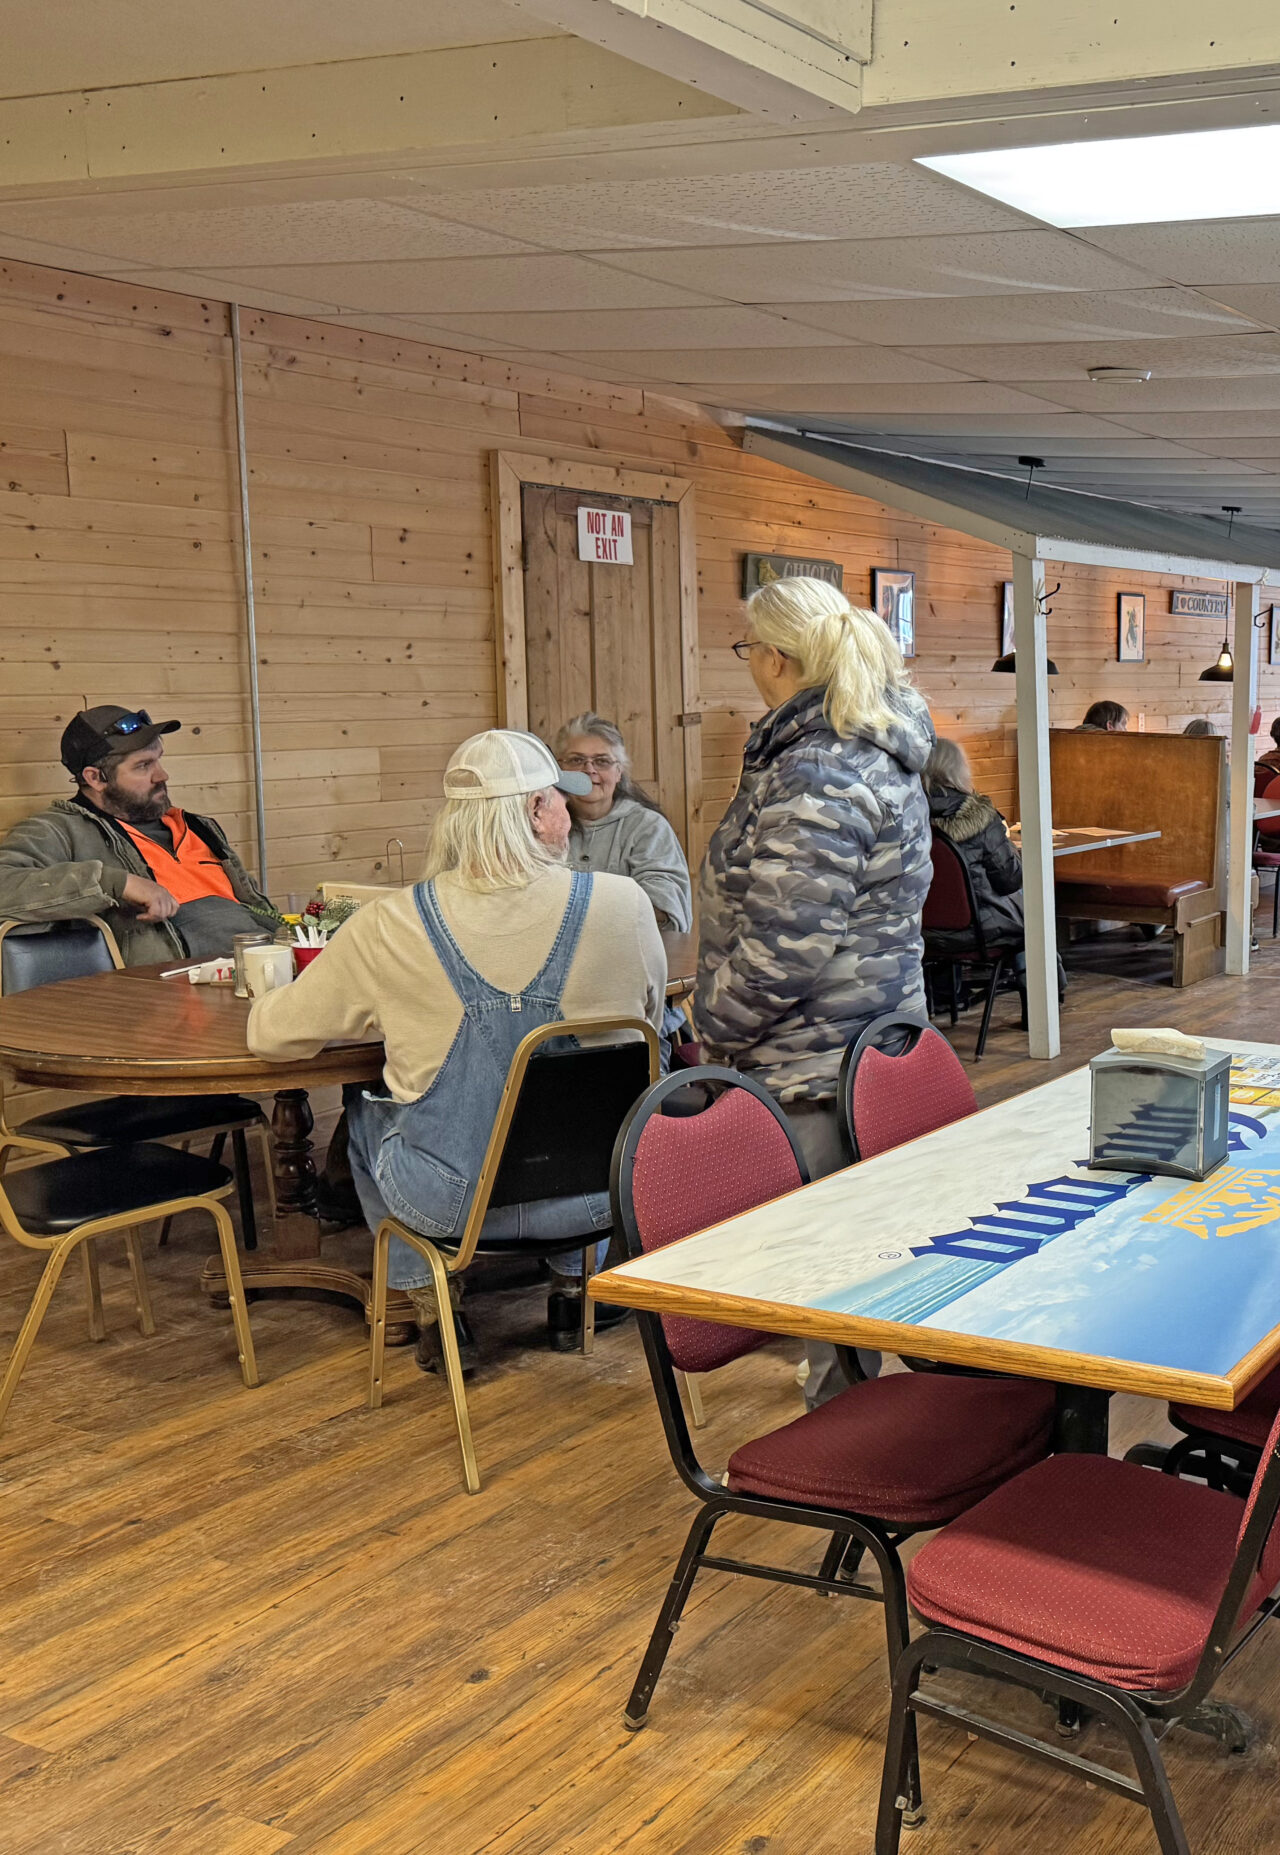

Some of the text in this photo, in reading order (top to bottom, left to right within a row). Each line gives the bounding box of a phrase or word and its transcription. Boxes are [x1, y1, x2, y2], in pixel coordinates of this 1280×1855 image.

[587, 511, 624, 537] NOT AN
[595, 536, 618, 561] EXIT
[1187, 596, 1227, 614] COUNTRY
